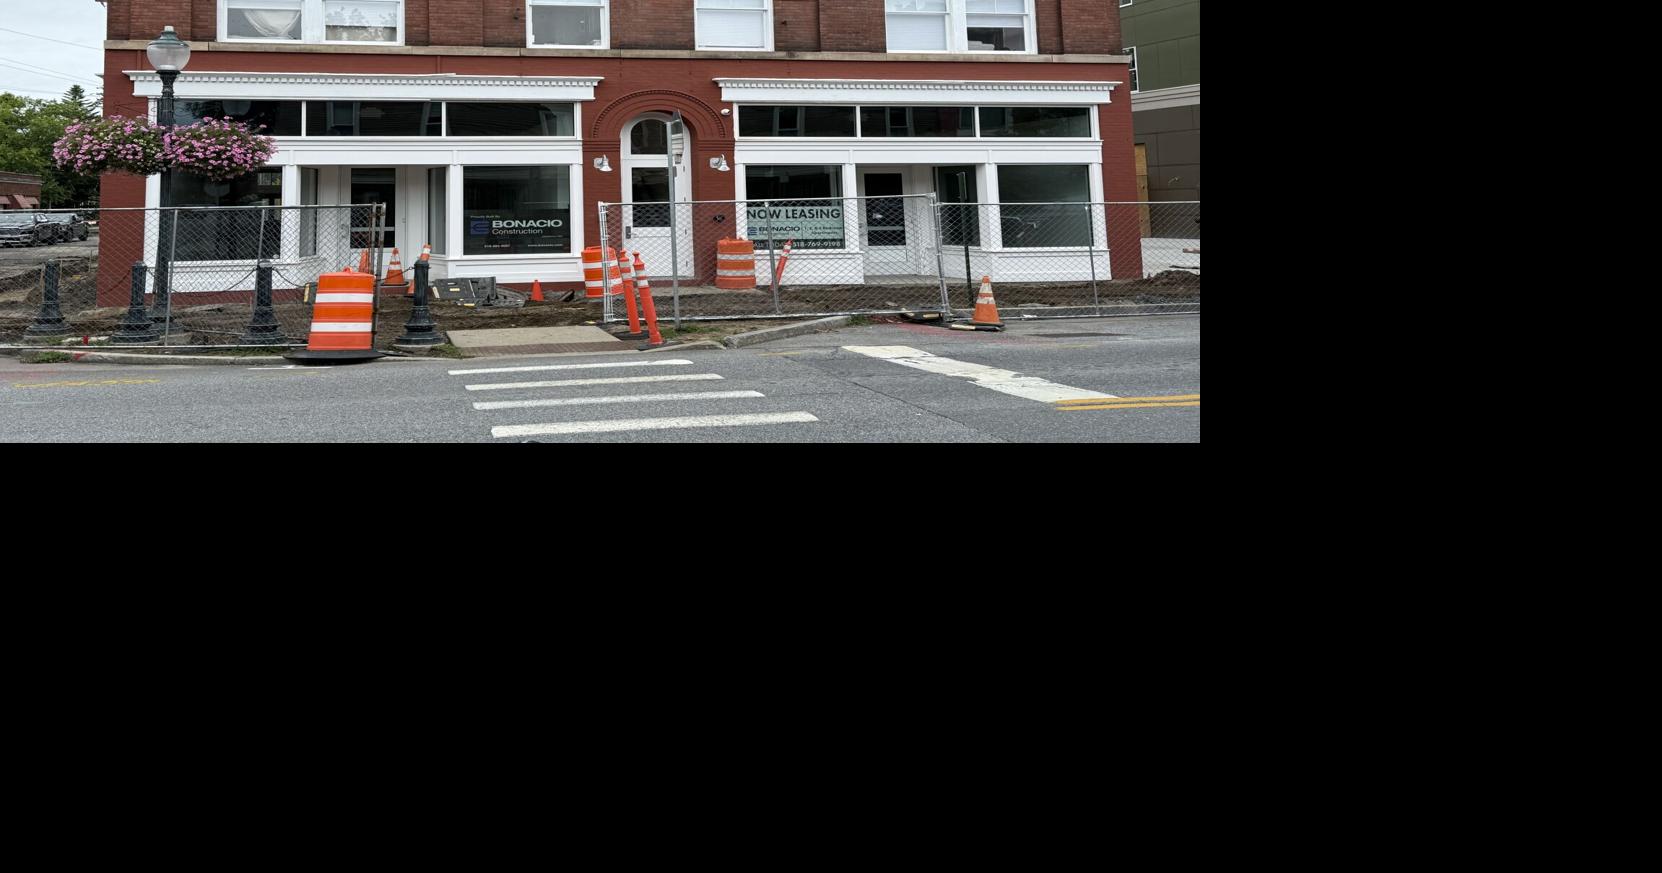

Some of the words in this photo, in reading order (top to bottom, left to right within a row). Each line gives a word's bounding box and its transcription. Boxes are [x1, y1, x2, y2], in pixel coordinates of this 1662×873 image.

[747, 209, 781, 219] NOW
[786, 208, 840, 219] LEASING
[492, 219, 563, 228] BONACIO
